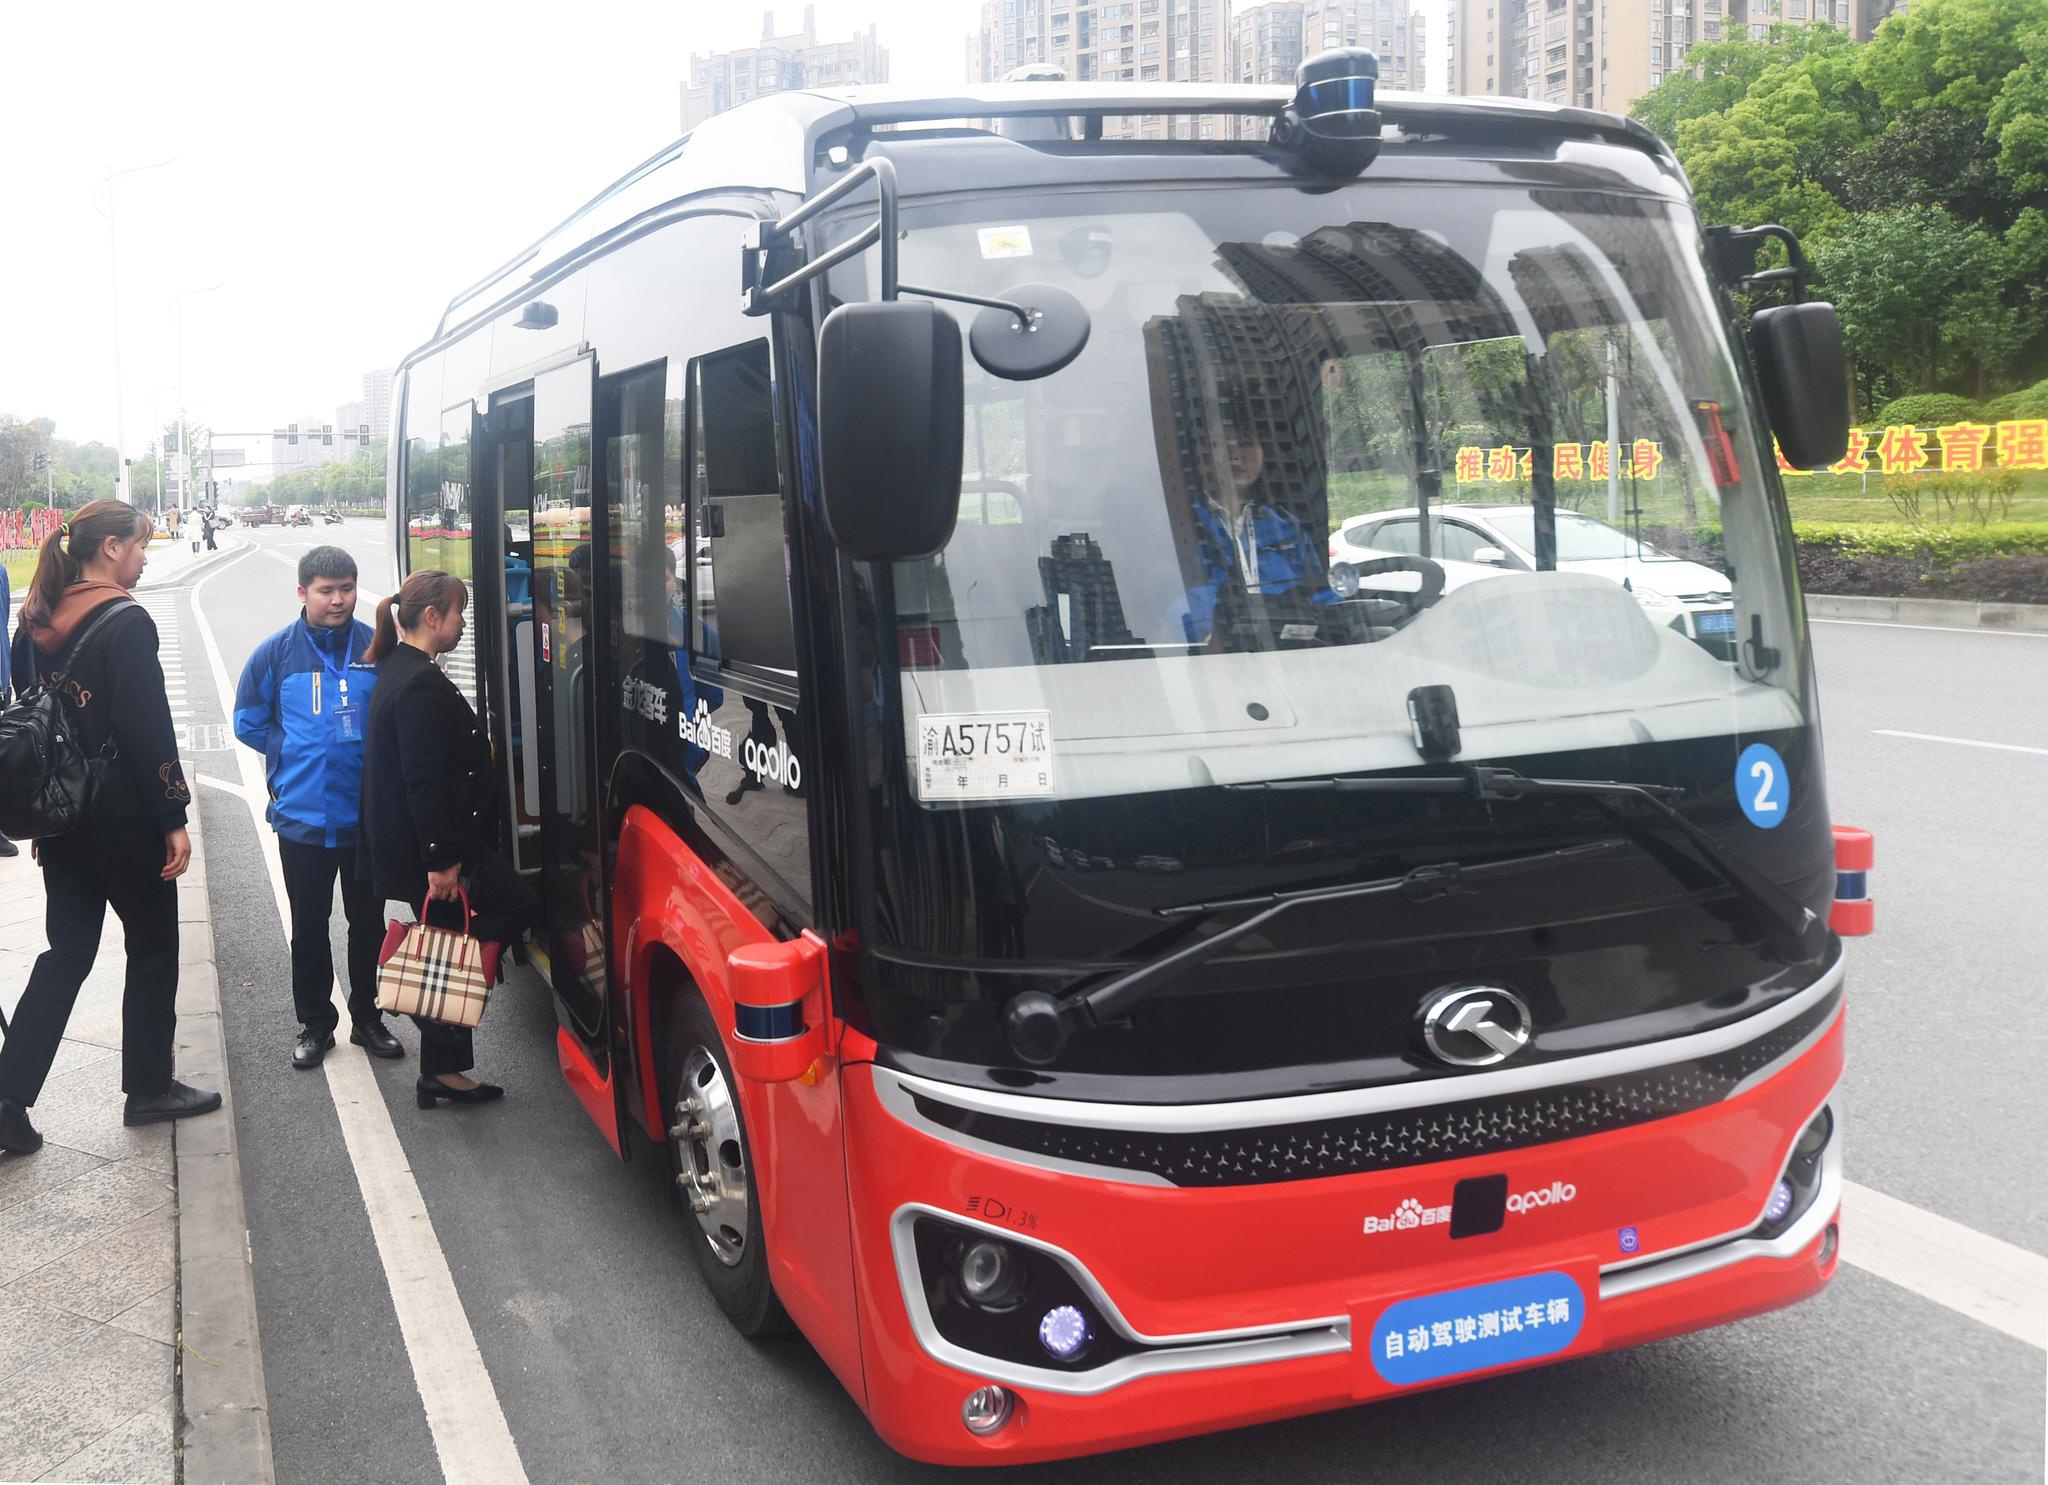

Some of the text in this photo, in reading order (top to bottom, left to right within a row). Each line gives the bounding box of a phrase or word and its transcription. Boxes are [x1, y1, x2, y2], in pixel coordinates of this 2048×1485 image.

[923, 721, 1046, 757] 渝A5757试
[744, 738, 801, 790] apollo
[957, 772, 1048, 789] 年 月 日
[1751, 760, 1778, 812] 2
[1506, 1181, 1577, 1215] apollo
[1385, 1297, 1570, 1359] 自动驾驶测试车辆
